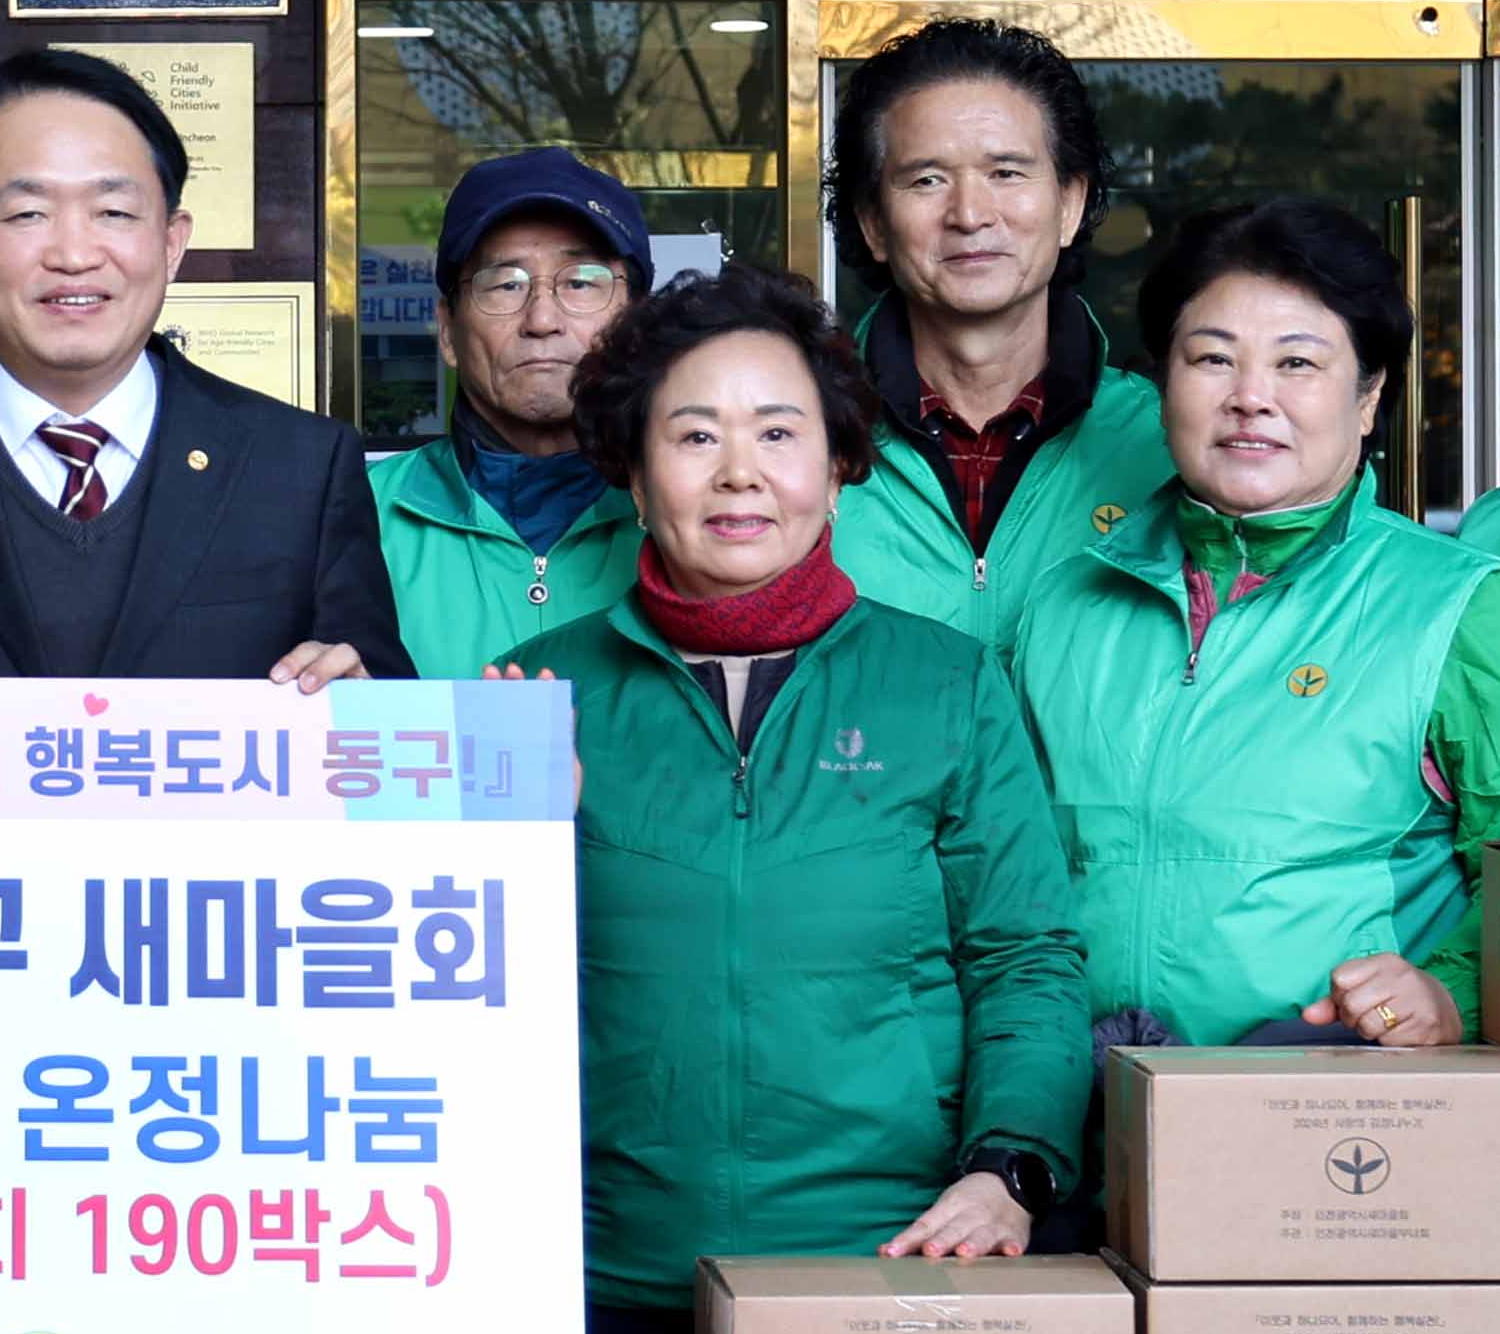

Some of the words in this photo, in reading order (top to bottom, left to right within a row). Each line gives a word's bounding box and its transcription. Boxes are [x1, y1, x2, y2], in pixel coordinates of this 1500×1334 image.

[170, 62, 199, 73] Child
[170, 75, 215, 88] Friendly
[170, 88, 201, 98] Cities
[170, 101, 220, 110] Initiative
[180, 133, 216, 142] ncheon
[24, 725, 293, 798] 행복도시
[69, 875, 507, 1008] 새마을회
[16, 1053, 444, 1163] 온정나눔
[75, 1182, 453, 1287] 190박스)
